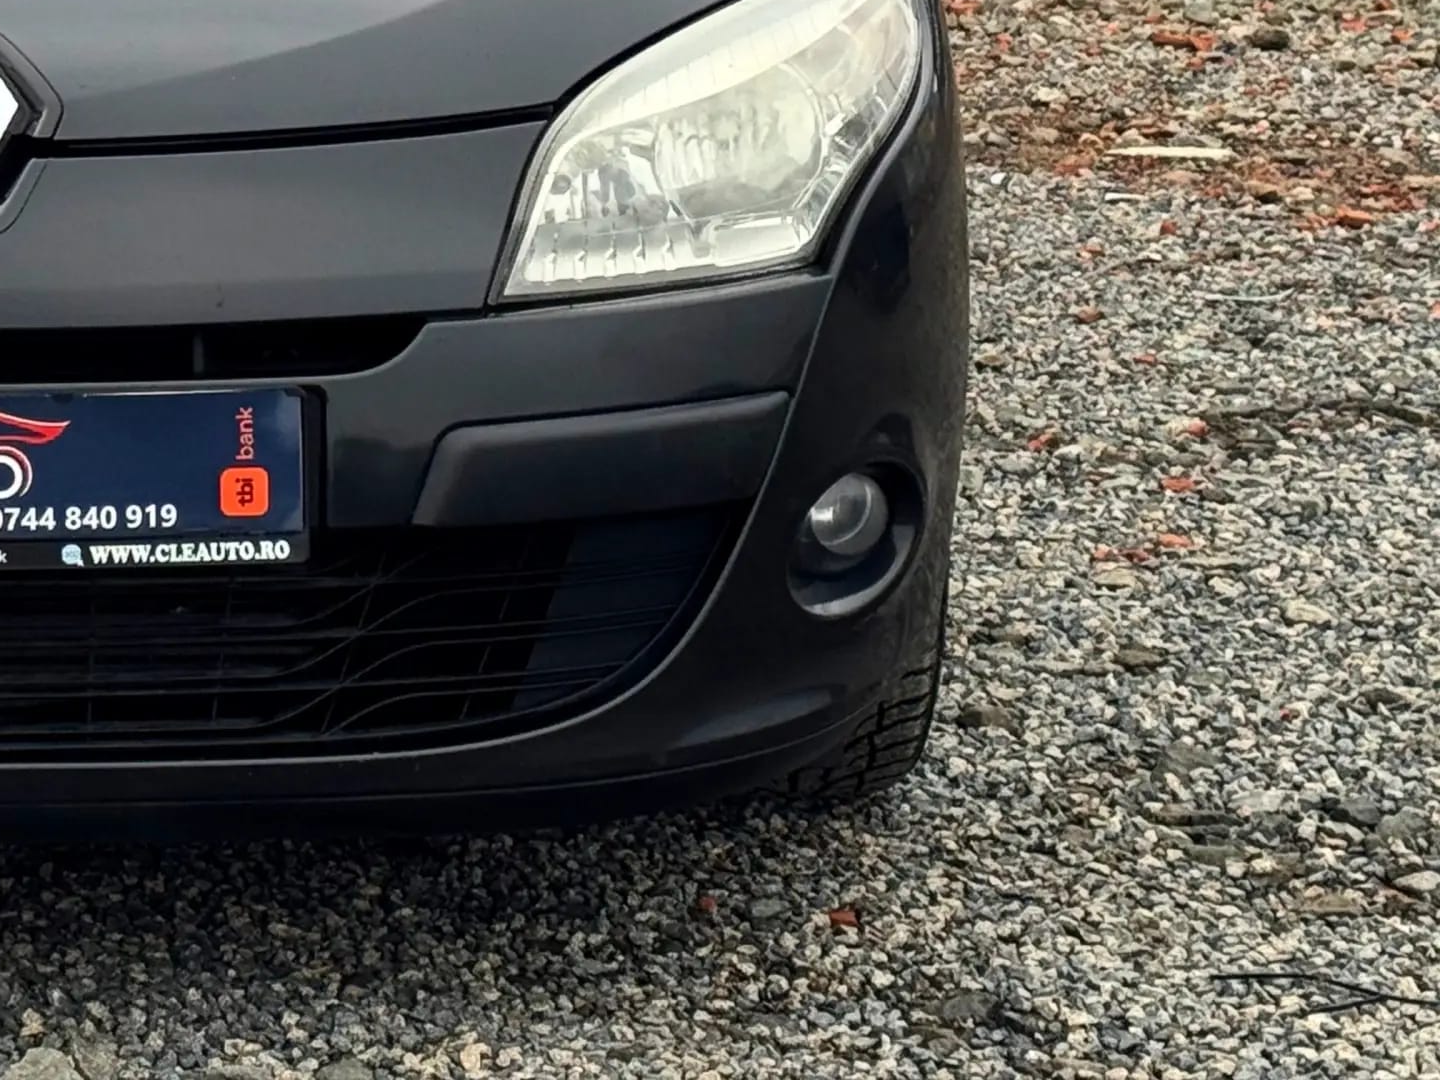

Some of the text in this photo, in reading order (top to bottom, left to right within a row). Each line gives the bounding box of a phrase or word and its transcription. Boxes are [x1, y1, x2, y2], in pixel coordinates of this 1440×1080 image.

[234, 406, 255, 460] bank
[234, 477, 254, 508] tbi
[64, 505, 118, 530] 840
[125, 503, 179, 529] 919
[89, 539, 291, 565] WWW.CLEAUTO.RO
